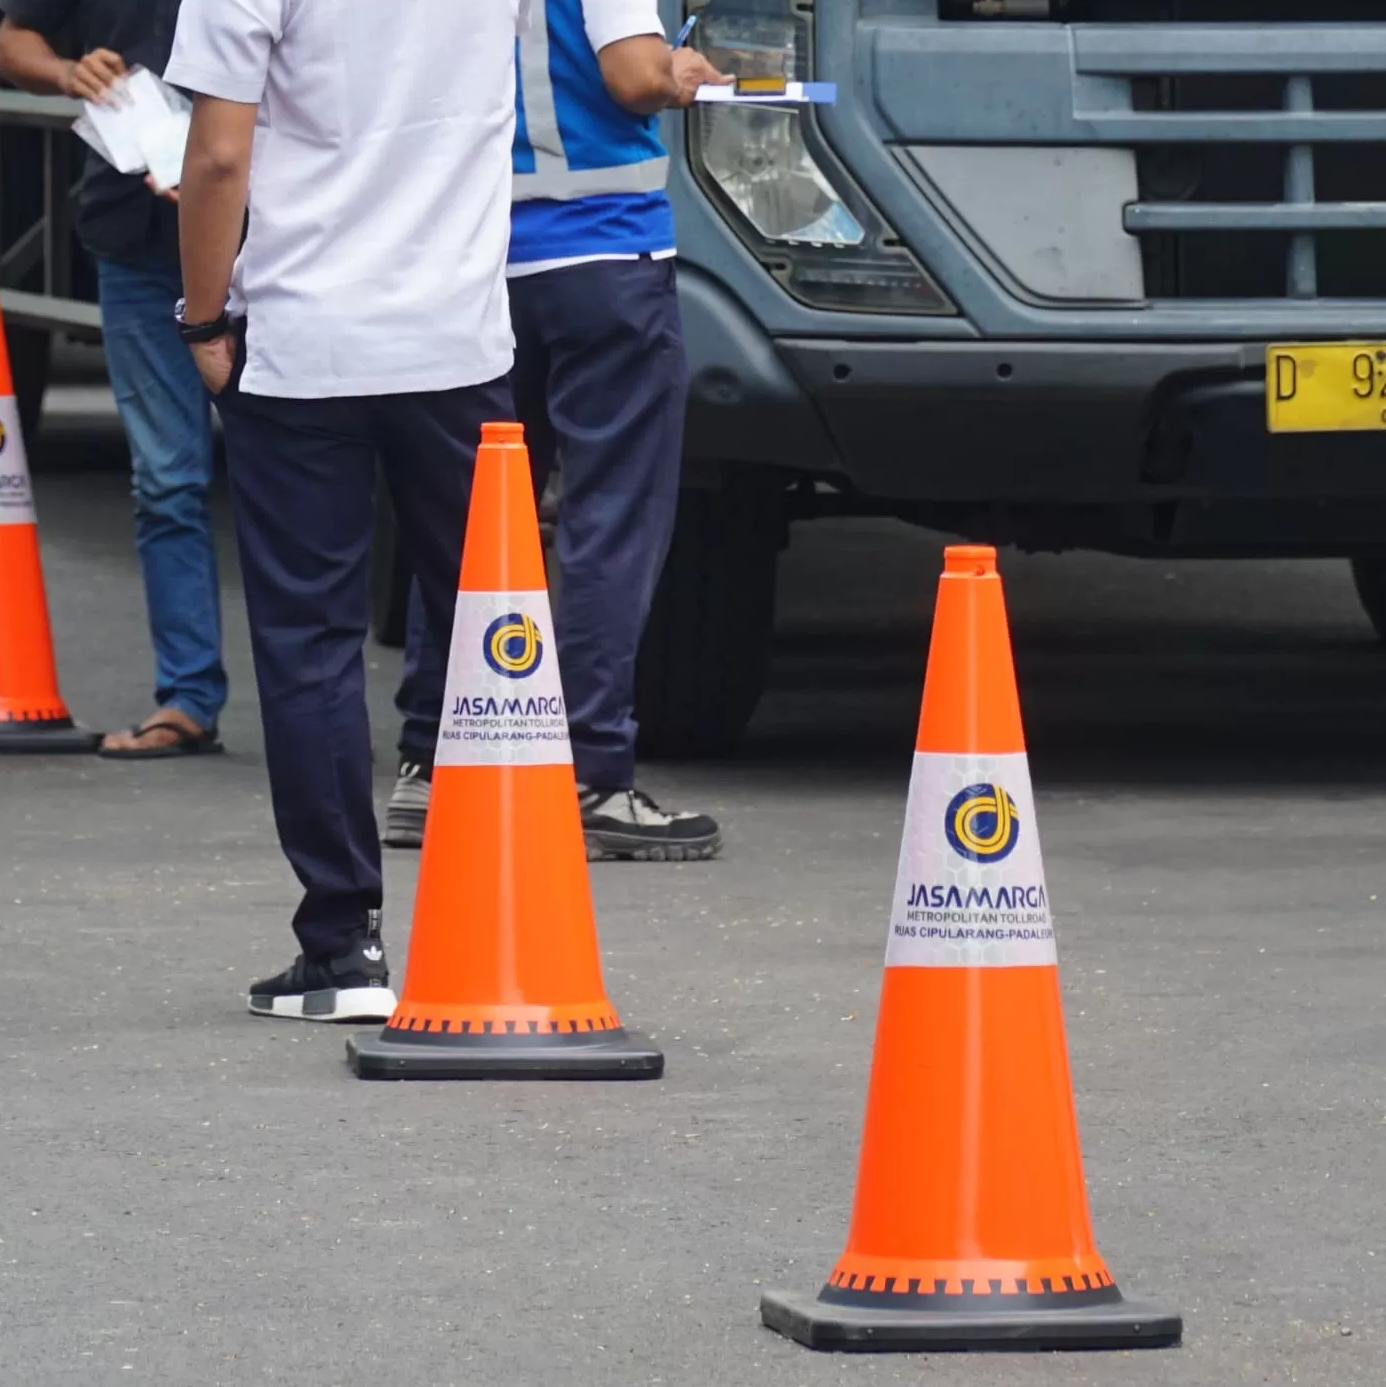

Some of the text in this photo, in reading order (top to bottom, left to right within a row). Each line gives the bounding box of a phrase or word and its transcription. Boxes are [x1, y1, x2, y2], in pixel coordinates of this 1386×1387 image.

[1275, 355, 1297, 401] D
[453, 718, 528, 727] METROPOLITAN
[907, 910, 998, 924] METROPOLITAN
[894, 925, 916, 938] RUAS
